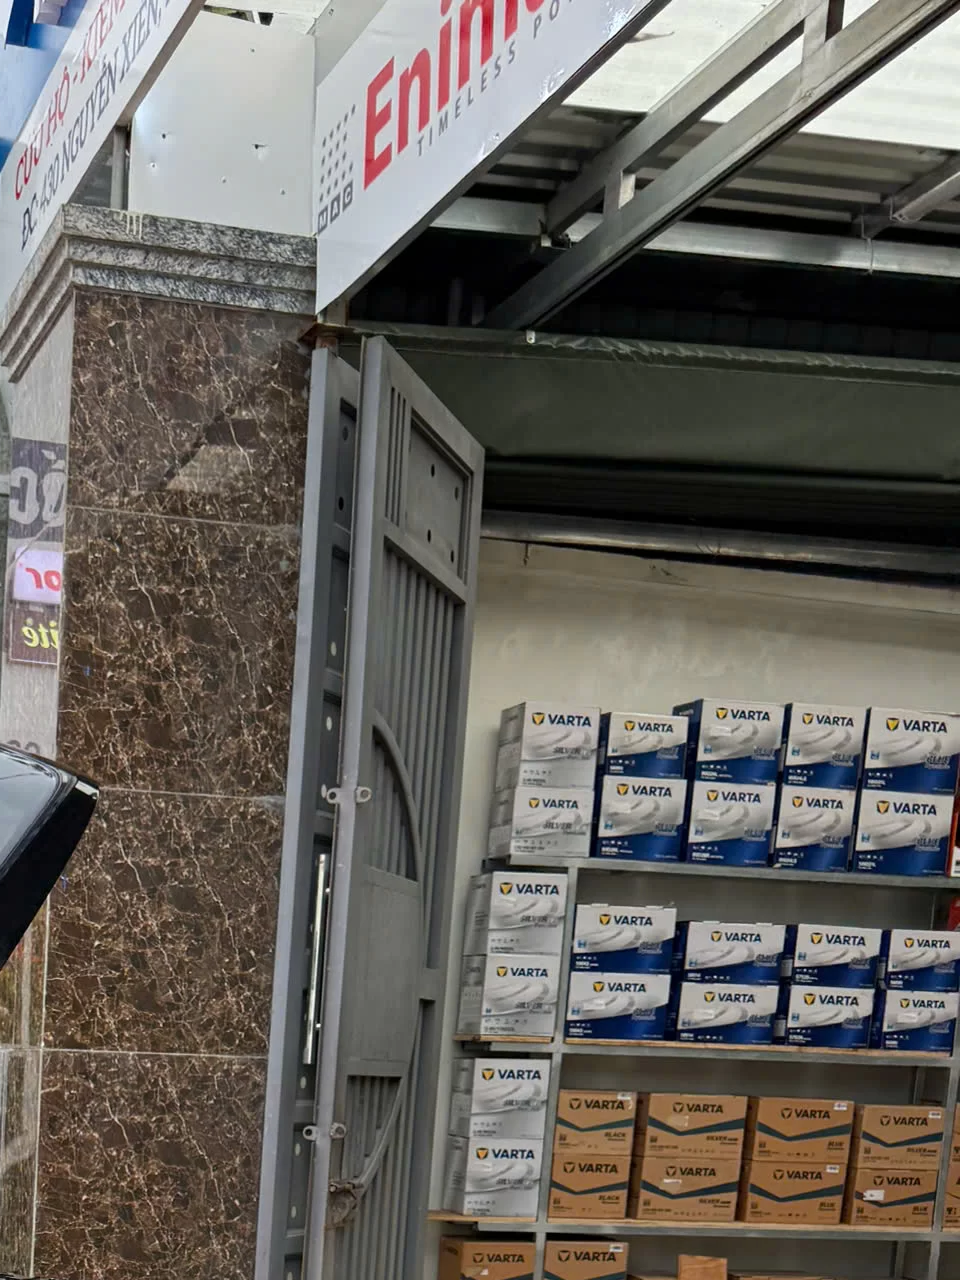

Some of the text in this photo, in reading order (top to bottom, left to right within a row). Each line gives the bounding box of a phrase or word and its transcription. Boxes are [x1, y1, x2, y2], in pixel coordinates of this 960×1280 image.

[363, 0, 544, 191] Enim
[416, 41, 516, 157] TIMELESS
[548, 714, 592, 727] VARTA
[731, 709, 770, 721] VARTA
[816, 715, 854, 727] VARTA
[903, 719, 948, 733] VARTA
[638, 722, 674, 733] VARTA
[632, 785, 672, 797] VARTA
[722, 791, 761, 803] VARTA
[542, 799, 579, 809] VARTA
[806, 798, 844, 809] VARTA
[893, 802, 937, 816] VARTA
[516, 883, 559, 896] VARTA
[613, 915, 653, 926] VARTA
[724, 932, 762, 943] VARTA
[826, 934, 866, 947] VARTA
[917, 938, 951, 949] VARTA
[511, 967, 548, 978] VARTA
[607, 982, 647, 993] VARTA
[718, 992, 755, 1004] VARTA
[819, 994, 859, 1006] VARTA
[912, 999, 946, 1009] VARTA
[498, 1069, 541, 1080] VARTA
[584, 1099, 625, 1110] VARTA
[686, 1103, 724, 1113] VARTA
[795, 1108, 830, 1119] VARTA
[893, 1116, 928, 1127] VARTA
[492, 1149, 535, 1160] VARTA
[578, 1162, 618, 1174] VARTA
[680, 1167, 716, 1177] VARTA
[787, 1171, 823, 1181] VARTA
[886, 1176, 921, 1186] VARTA
[487, 1253, 525, 1263] VARTA
[574, 1250, 617, 1262] VARTA
